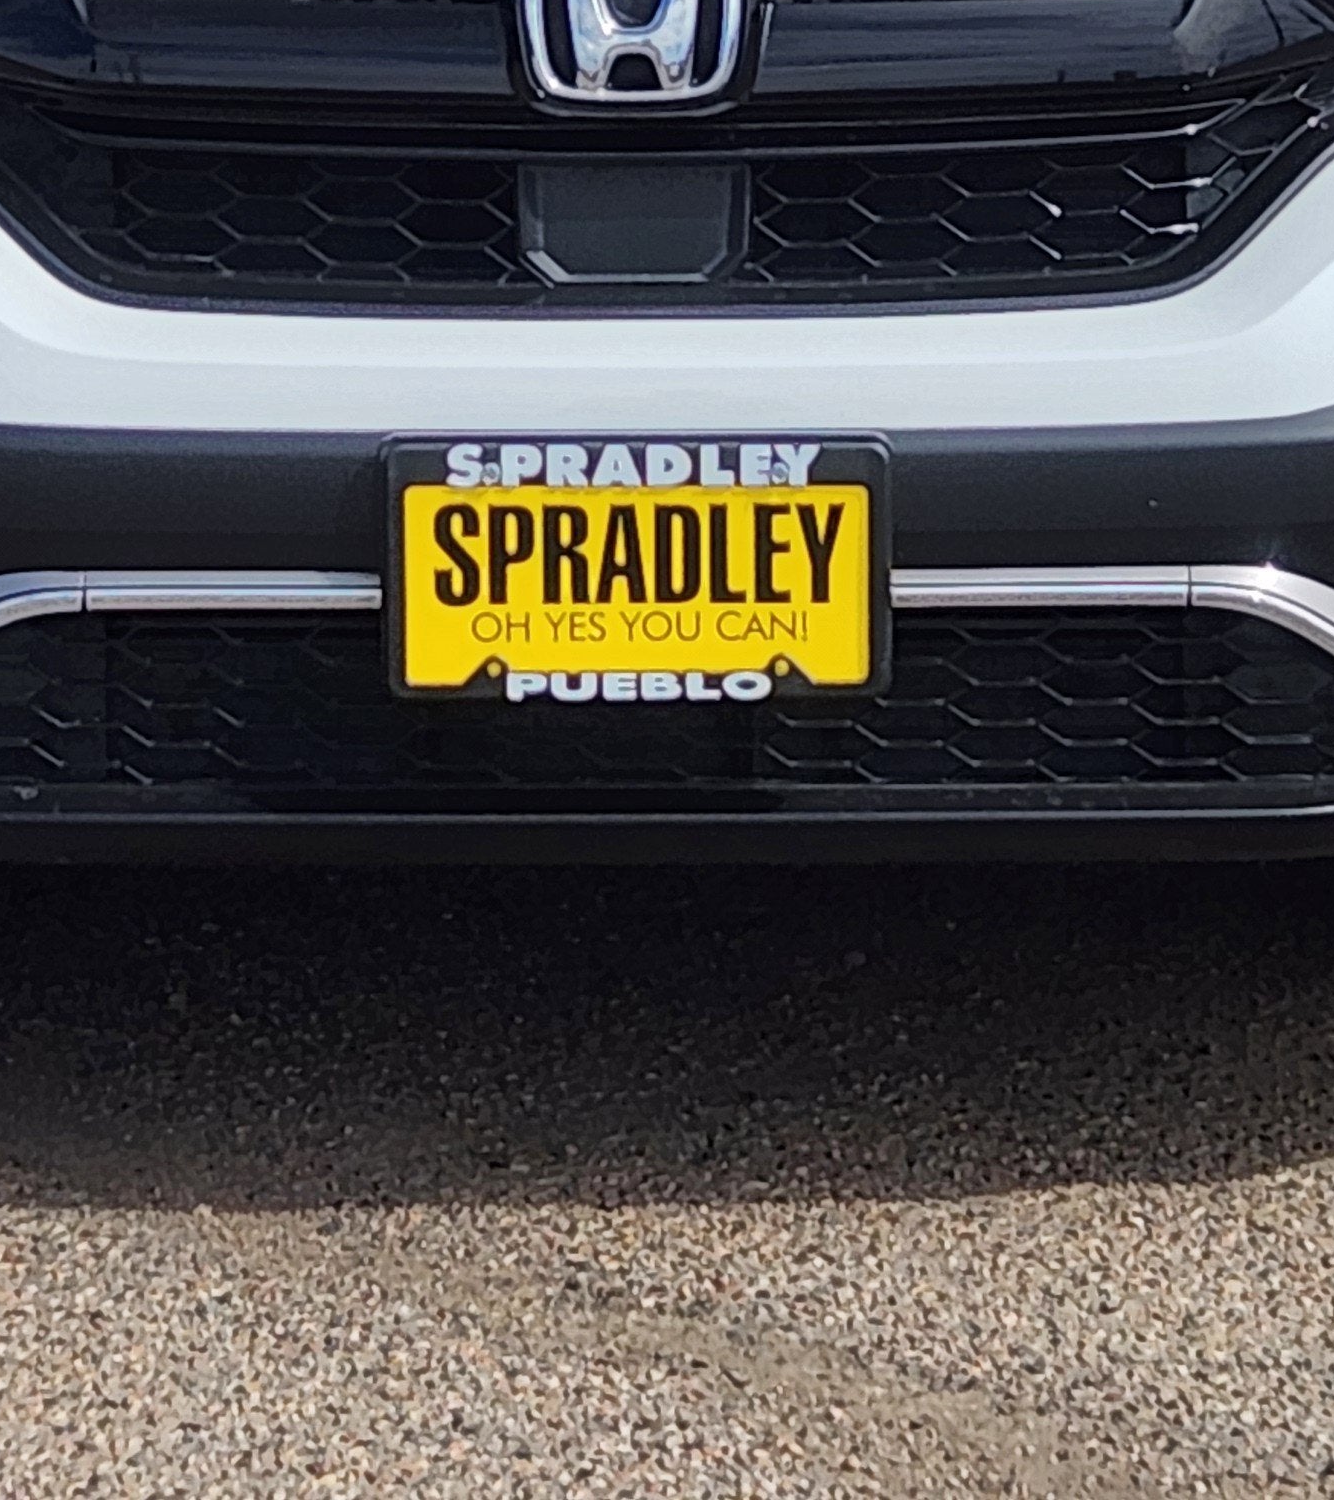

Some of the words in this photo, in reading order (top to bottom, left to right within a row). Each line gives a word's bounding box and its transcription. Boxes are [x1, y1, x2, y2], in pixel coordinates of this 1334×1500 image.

[446, 442, 821, 488] SPRADLEY
[433, 502, 846, 607] SPRADLEY
[471, 610, 531, 644] OH
[544, 610, 607, 643] YES
[620, 610, 702, 643] YOU
[716, 610, 808, 643] CAN!
[505, 670, 773, 702] PUEBLO
